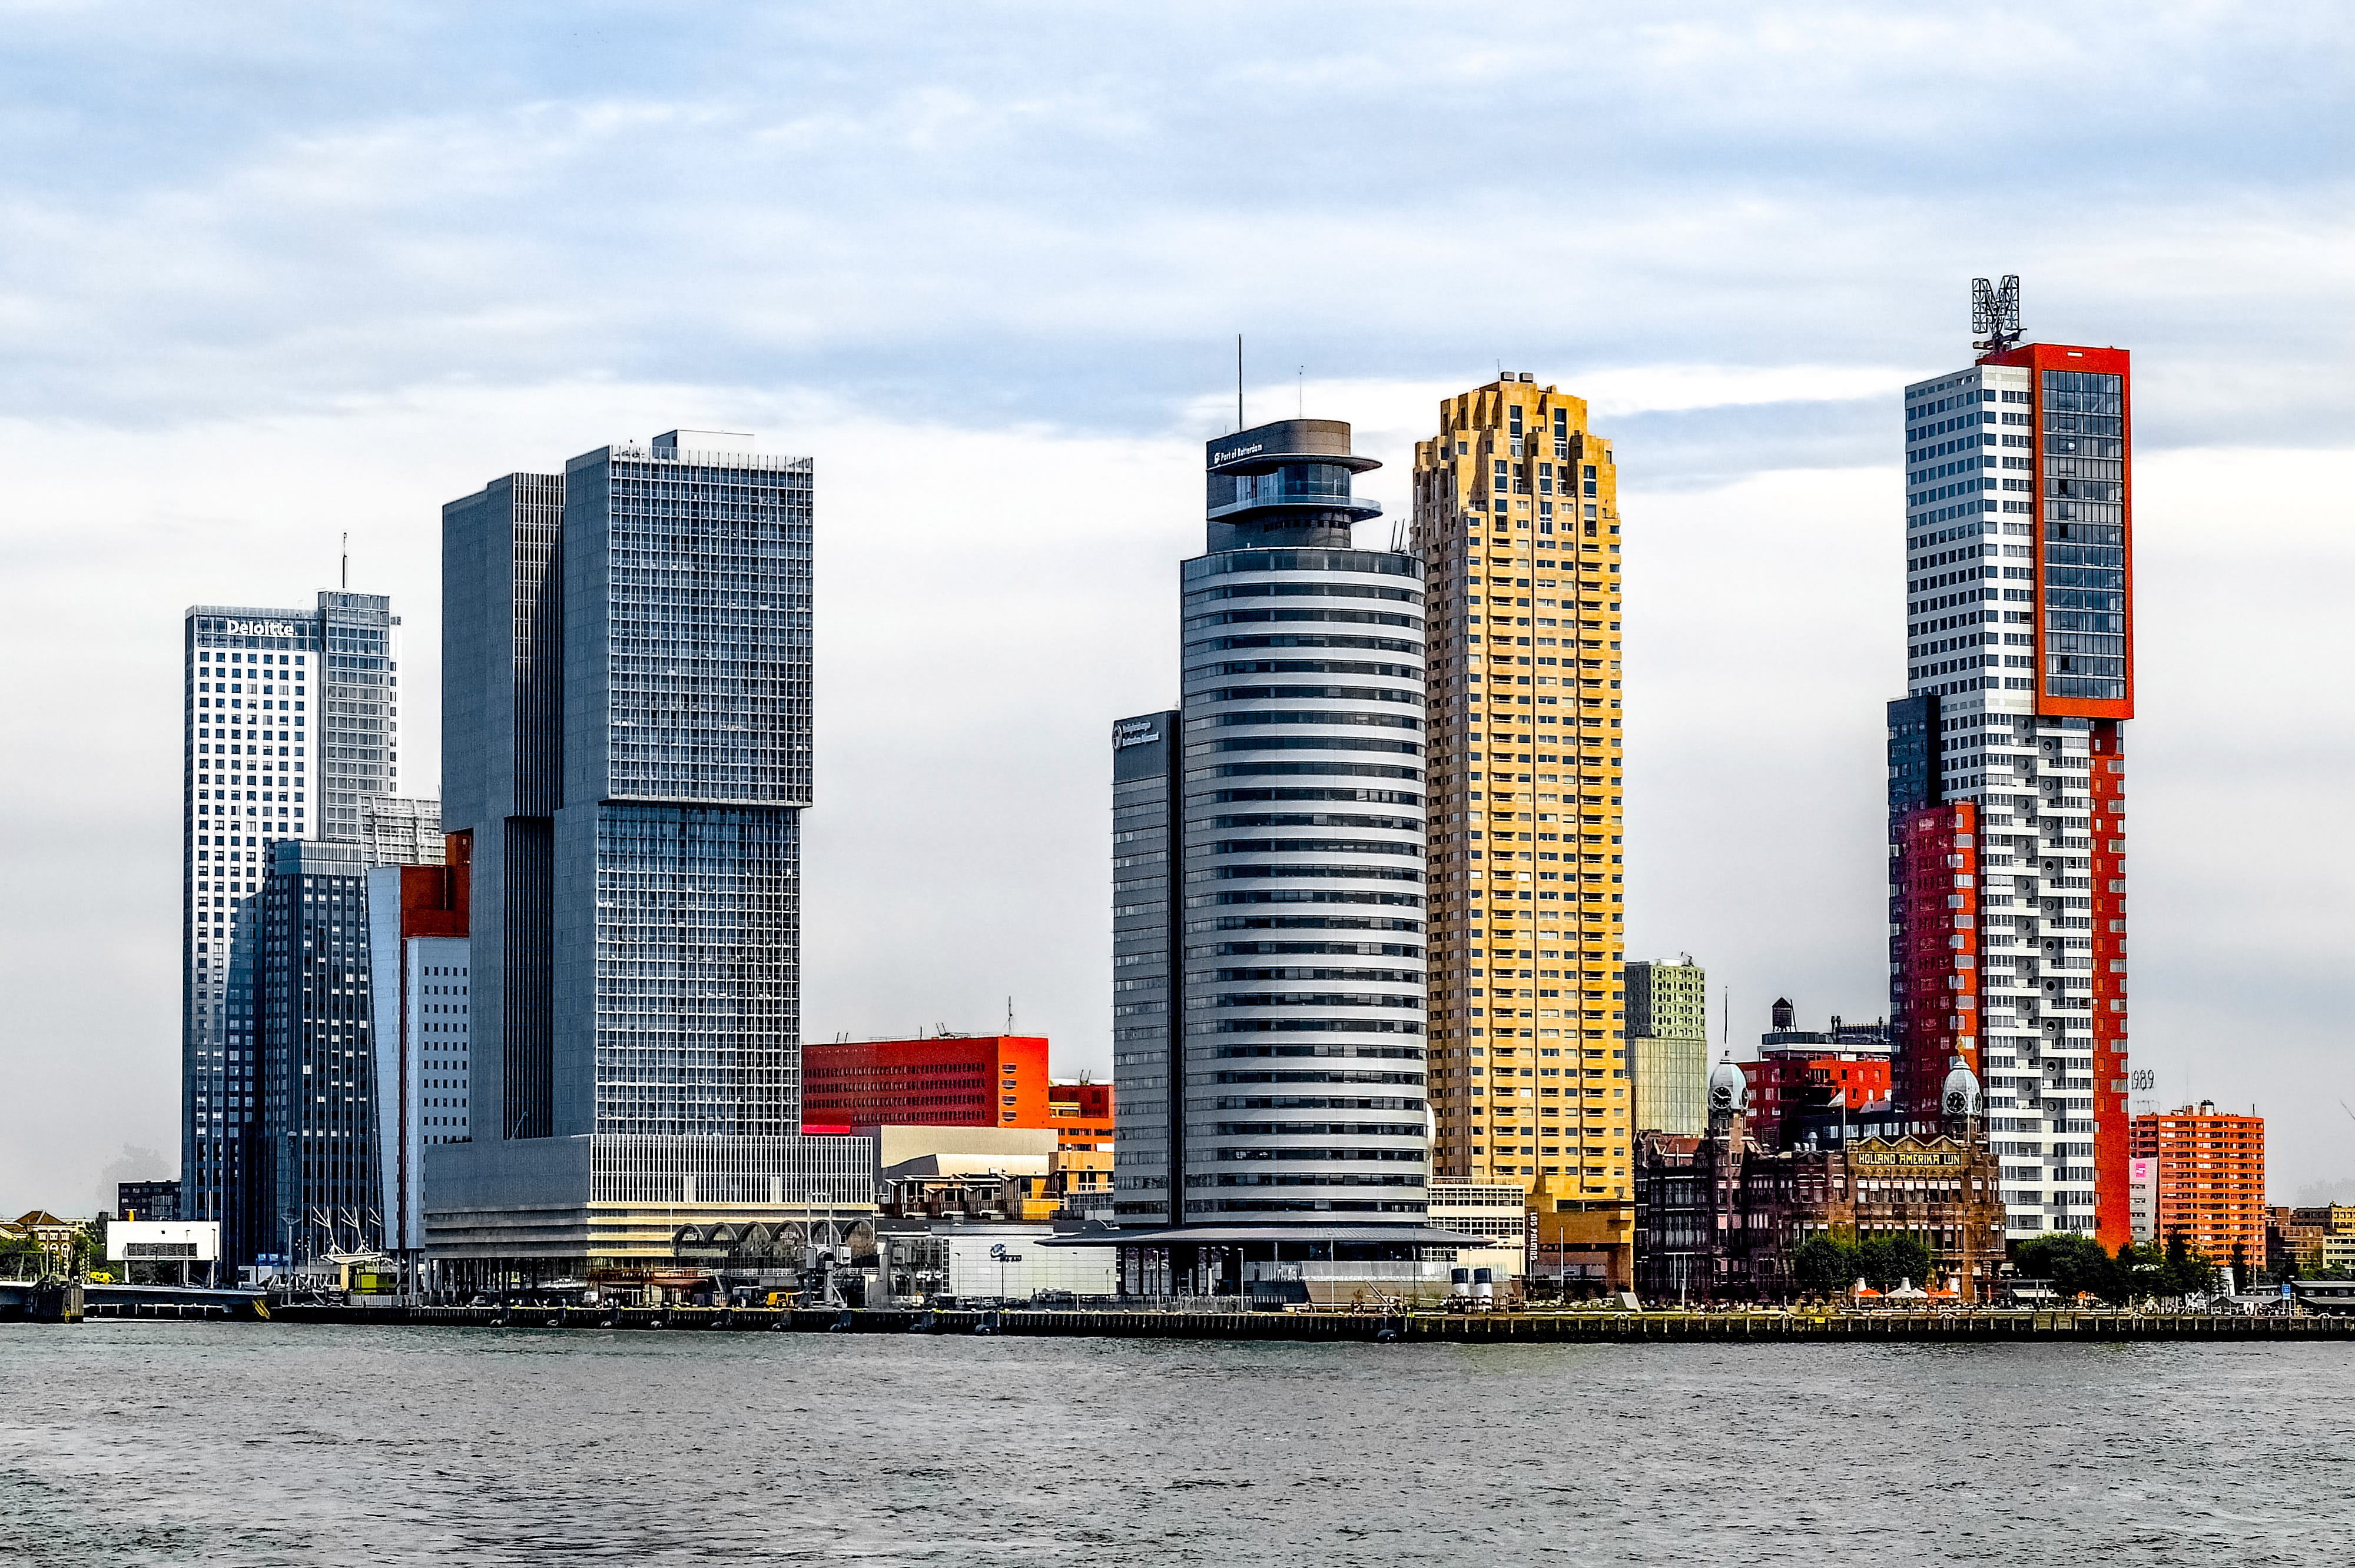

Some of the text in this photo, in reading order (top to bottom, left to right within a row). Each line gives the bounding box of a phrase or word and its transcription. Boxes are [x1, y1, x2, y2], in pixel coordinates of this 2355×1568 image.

[1221, 443, 1262, 462] Port of Rotterdam
[1859, 1154, 1895, 1164] HOLLAND
[1899, 1154, 1939, 1165] AMERIKA
